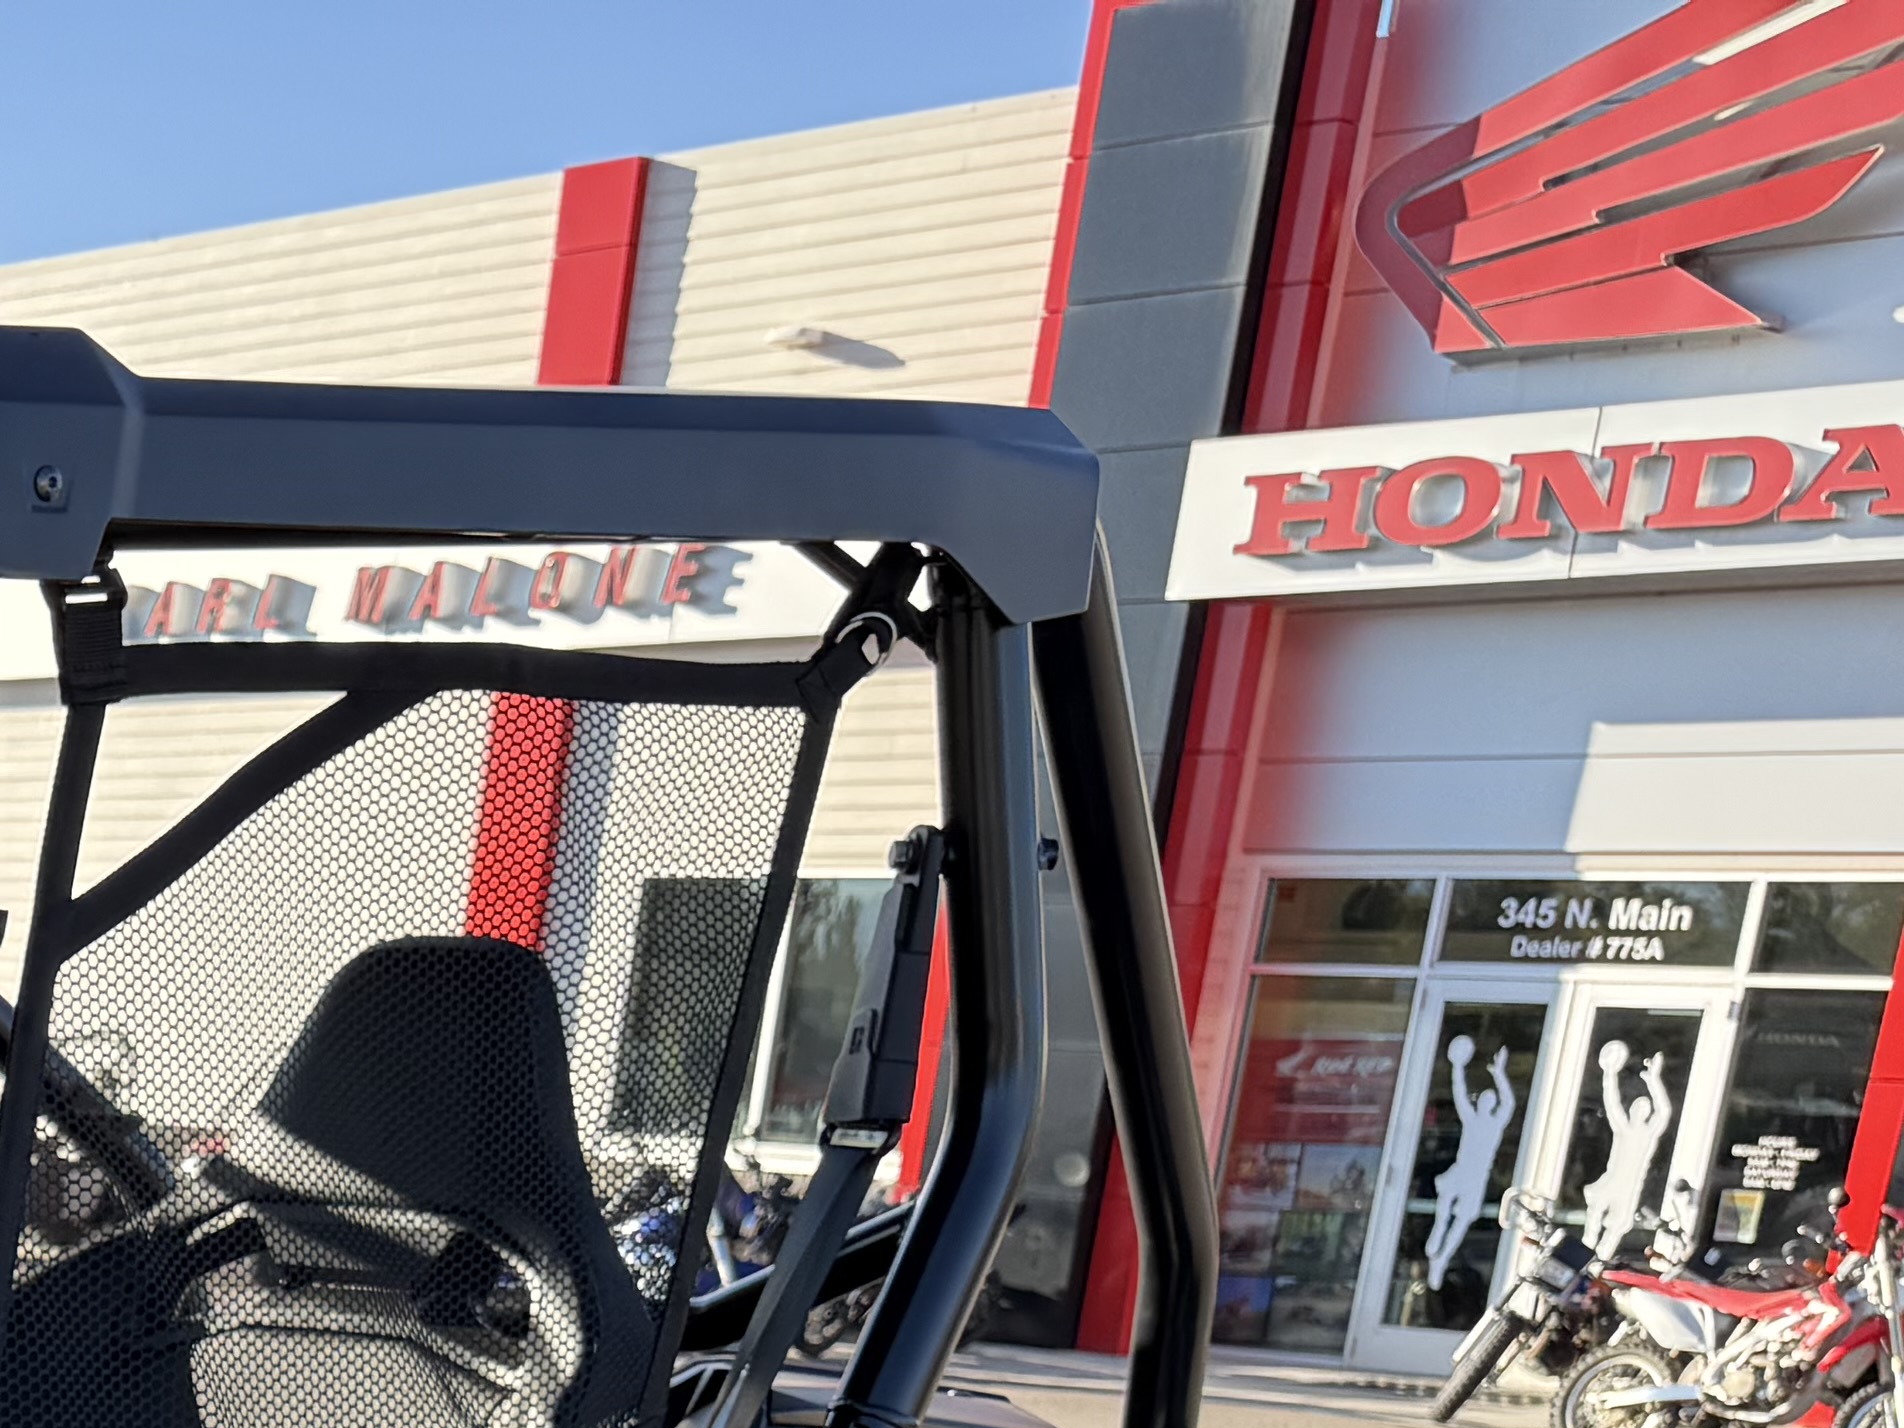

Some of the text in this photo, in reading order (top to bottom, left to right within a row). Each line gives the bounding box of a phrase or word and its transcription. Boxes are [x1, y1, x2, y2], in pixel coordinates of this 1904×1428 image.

[1233, 423, 1904, 556] HONDA
[344, 543, 706, 624] MALONE
[1497, 896, 1694, 931] 345 N. Main
[1510, 934, 1582, 959] Dealer
